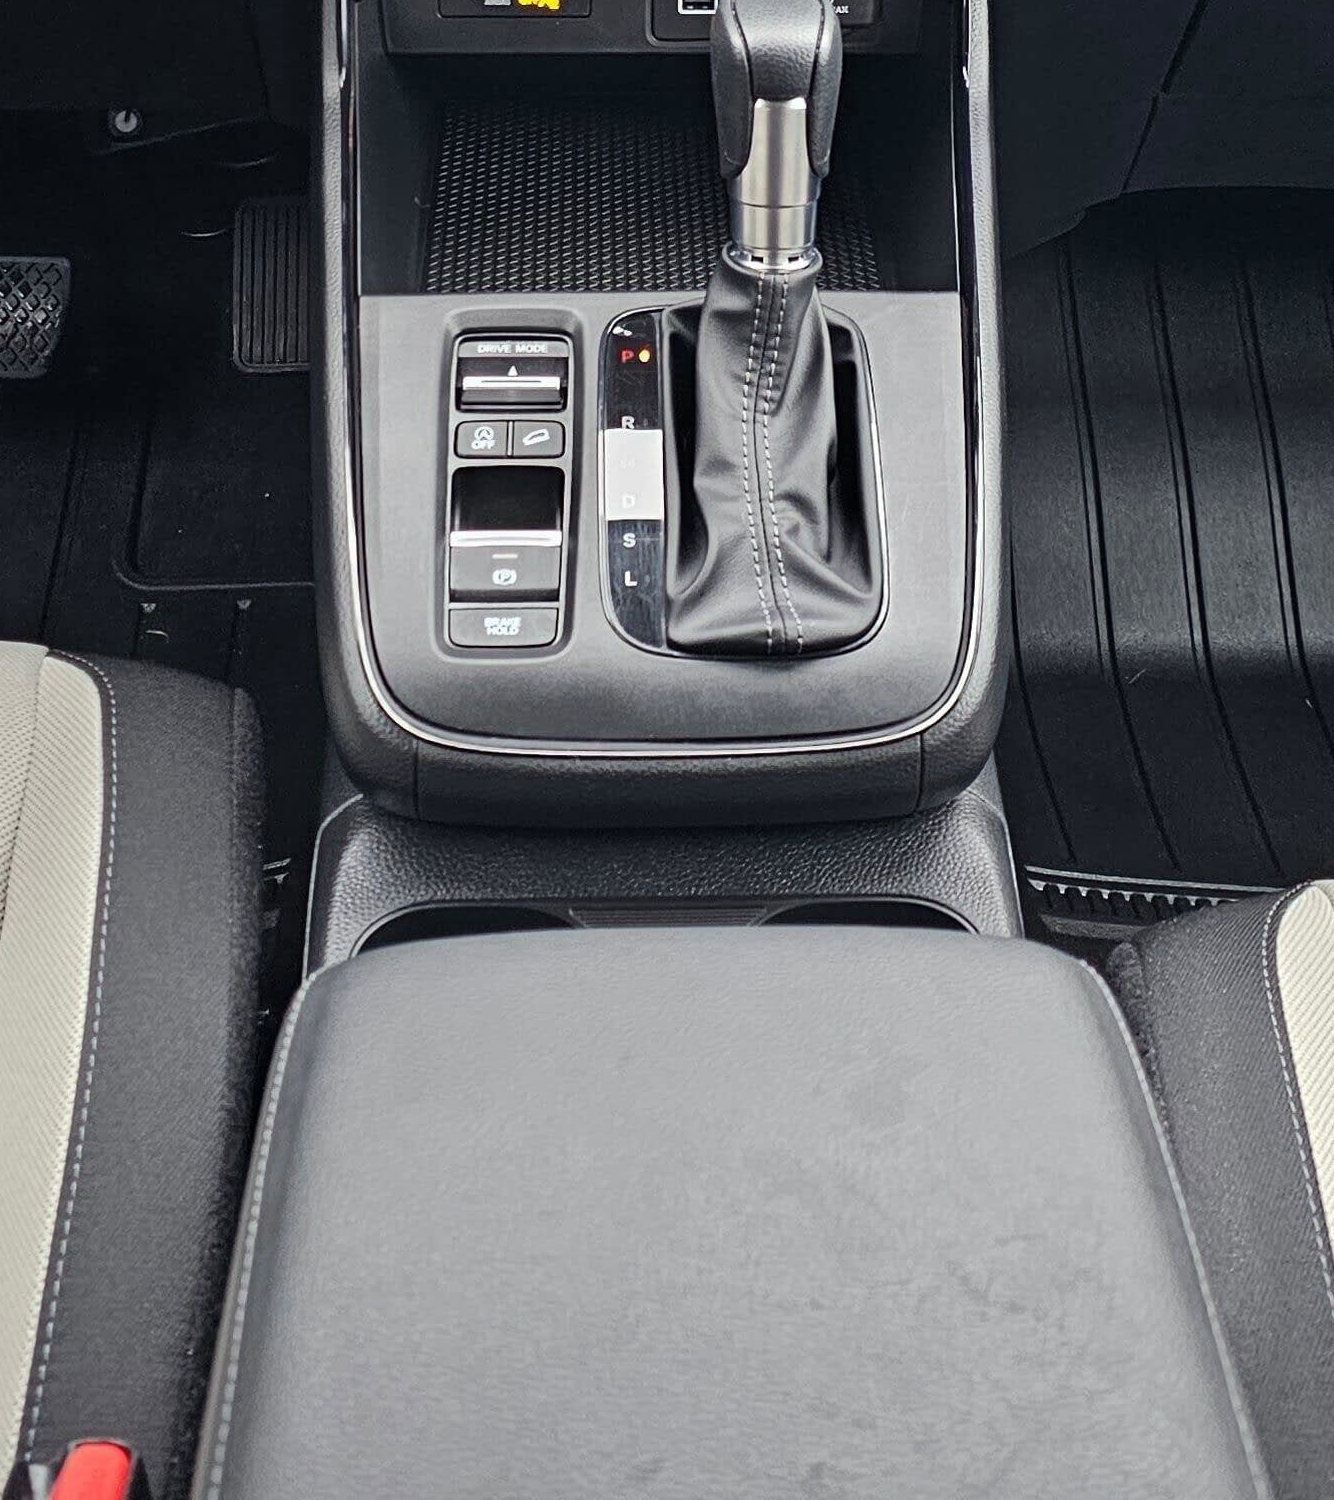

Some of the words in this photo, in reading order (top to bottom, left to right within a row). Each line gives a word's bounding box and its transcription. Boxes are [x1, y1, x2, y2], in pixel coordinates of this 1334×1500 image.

[477, 343, 511, 354] DRIVE
[515, 343, 547, 354] MODE
[621, 350, 634, 364] P
[621, 415, 635, 430] R
[471, 439, 496, 450] OFF
[622, 533, 636, 548] S
[624, 571, 638, 587] L
[483, 617, 522, 628] BRAKE
[485, 626, 520, 636] HOLD
